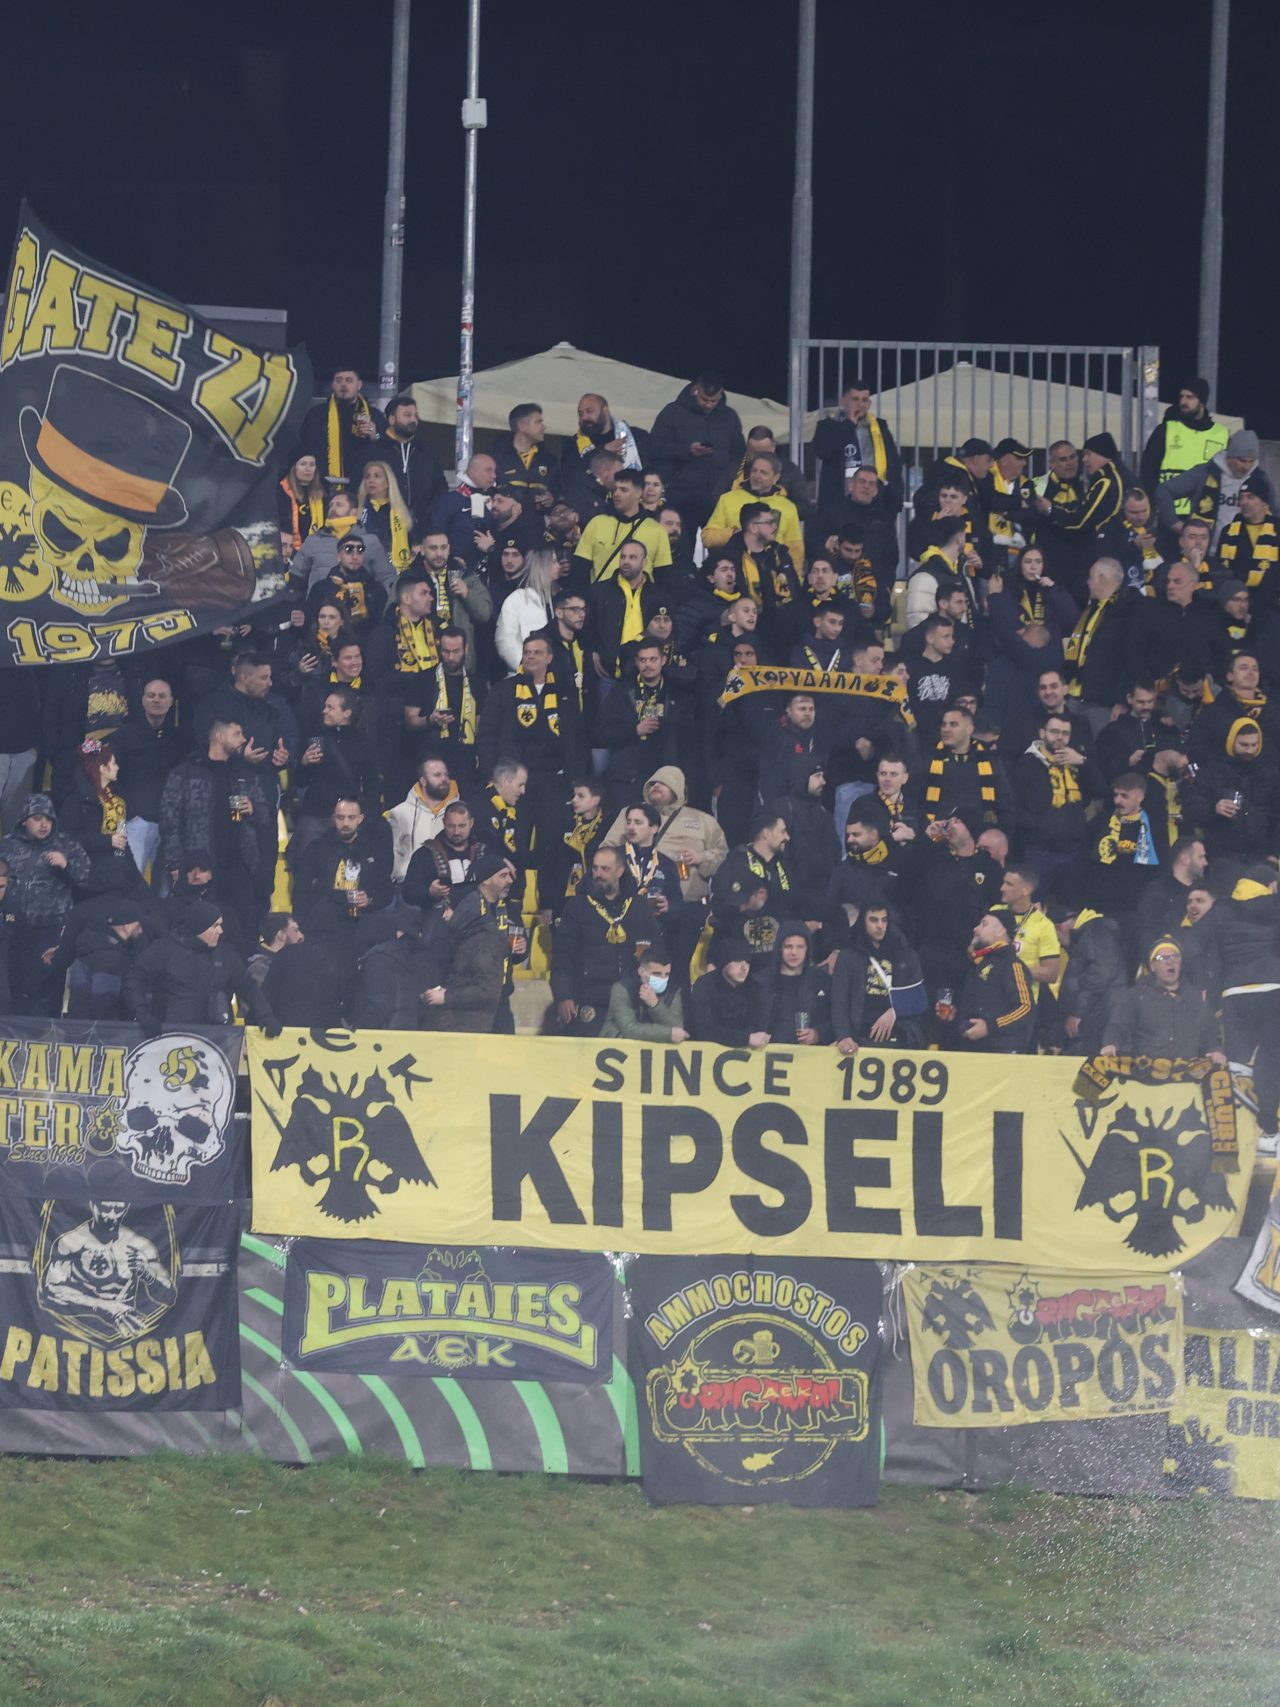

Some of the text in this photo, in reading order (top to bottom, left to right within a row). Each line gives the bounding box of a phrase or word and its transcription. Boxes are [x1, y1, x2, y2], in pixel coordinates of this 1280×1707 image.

[0, 227, 298, 467] GATE 21
[7, 608, 197, 665] 1975
[592, 1046, 949, 1106] SINCE 1989
[332, 1116, 370, 1182] R
[490, 1092, 1024, 1241] KIPSELI
[1139, 1148, 1175, 1209] R
[307, 1270, 585, 1338] PLATAIES
[644, 1270, 870, 1357] AMMOCHOSTOS
[389, 1335, 518, 1369] AEK
[927, 1334, 1178, 1416] OROPOS
